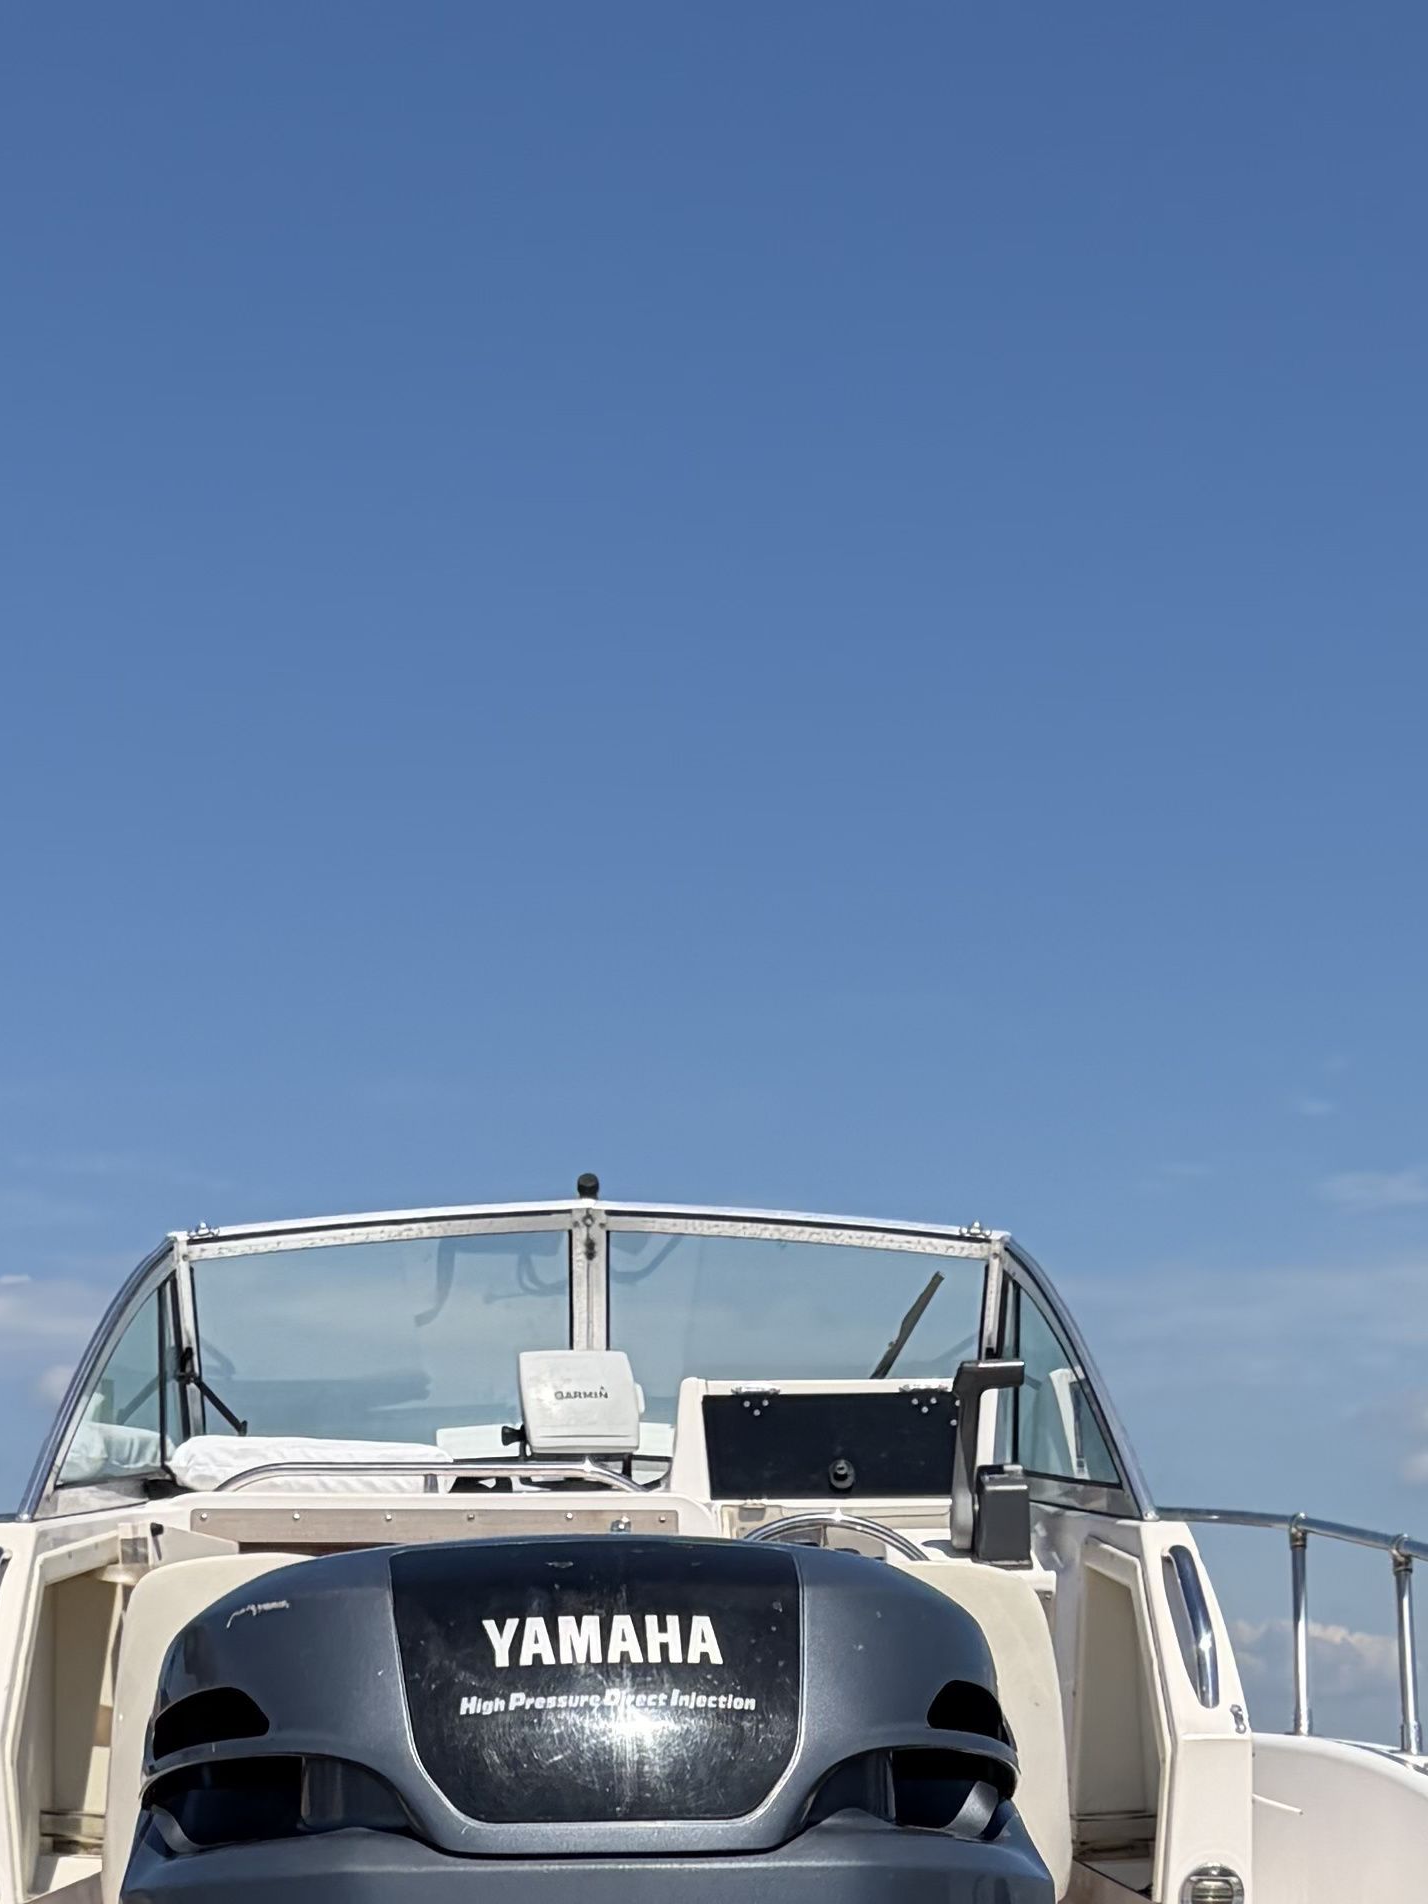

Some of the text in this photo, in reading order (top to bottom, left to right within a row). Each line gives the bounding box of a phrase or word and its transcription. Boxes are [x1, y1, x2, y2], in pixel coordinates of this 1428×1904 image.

[482, 1614, 723, 1667] YAMAHA
[459, 1687, 757, 1716] High Pressure Direct Injection
